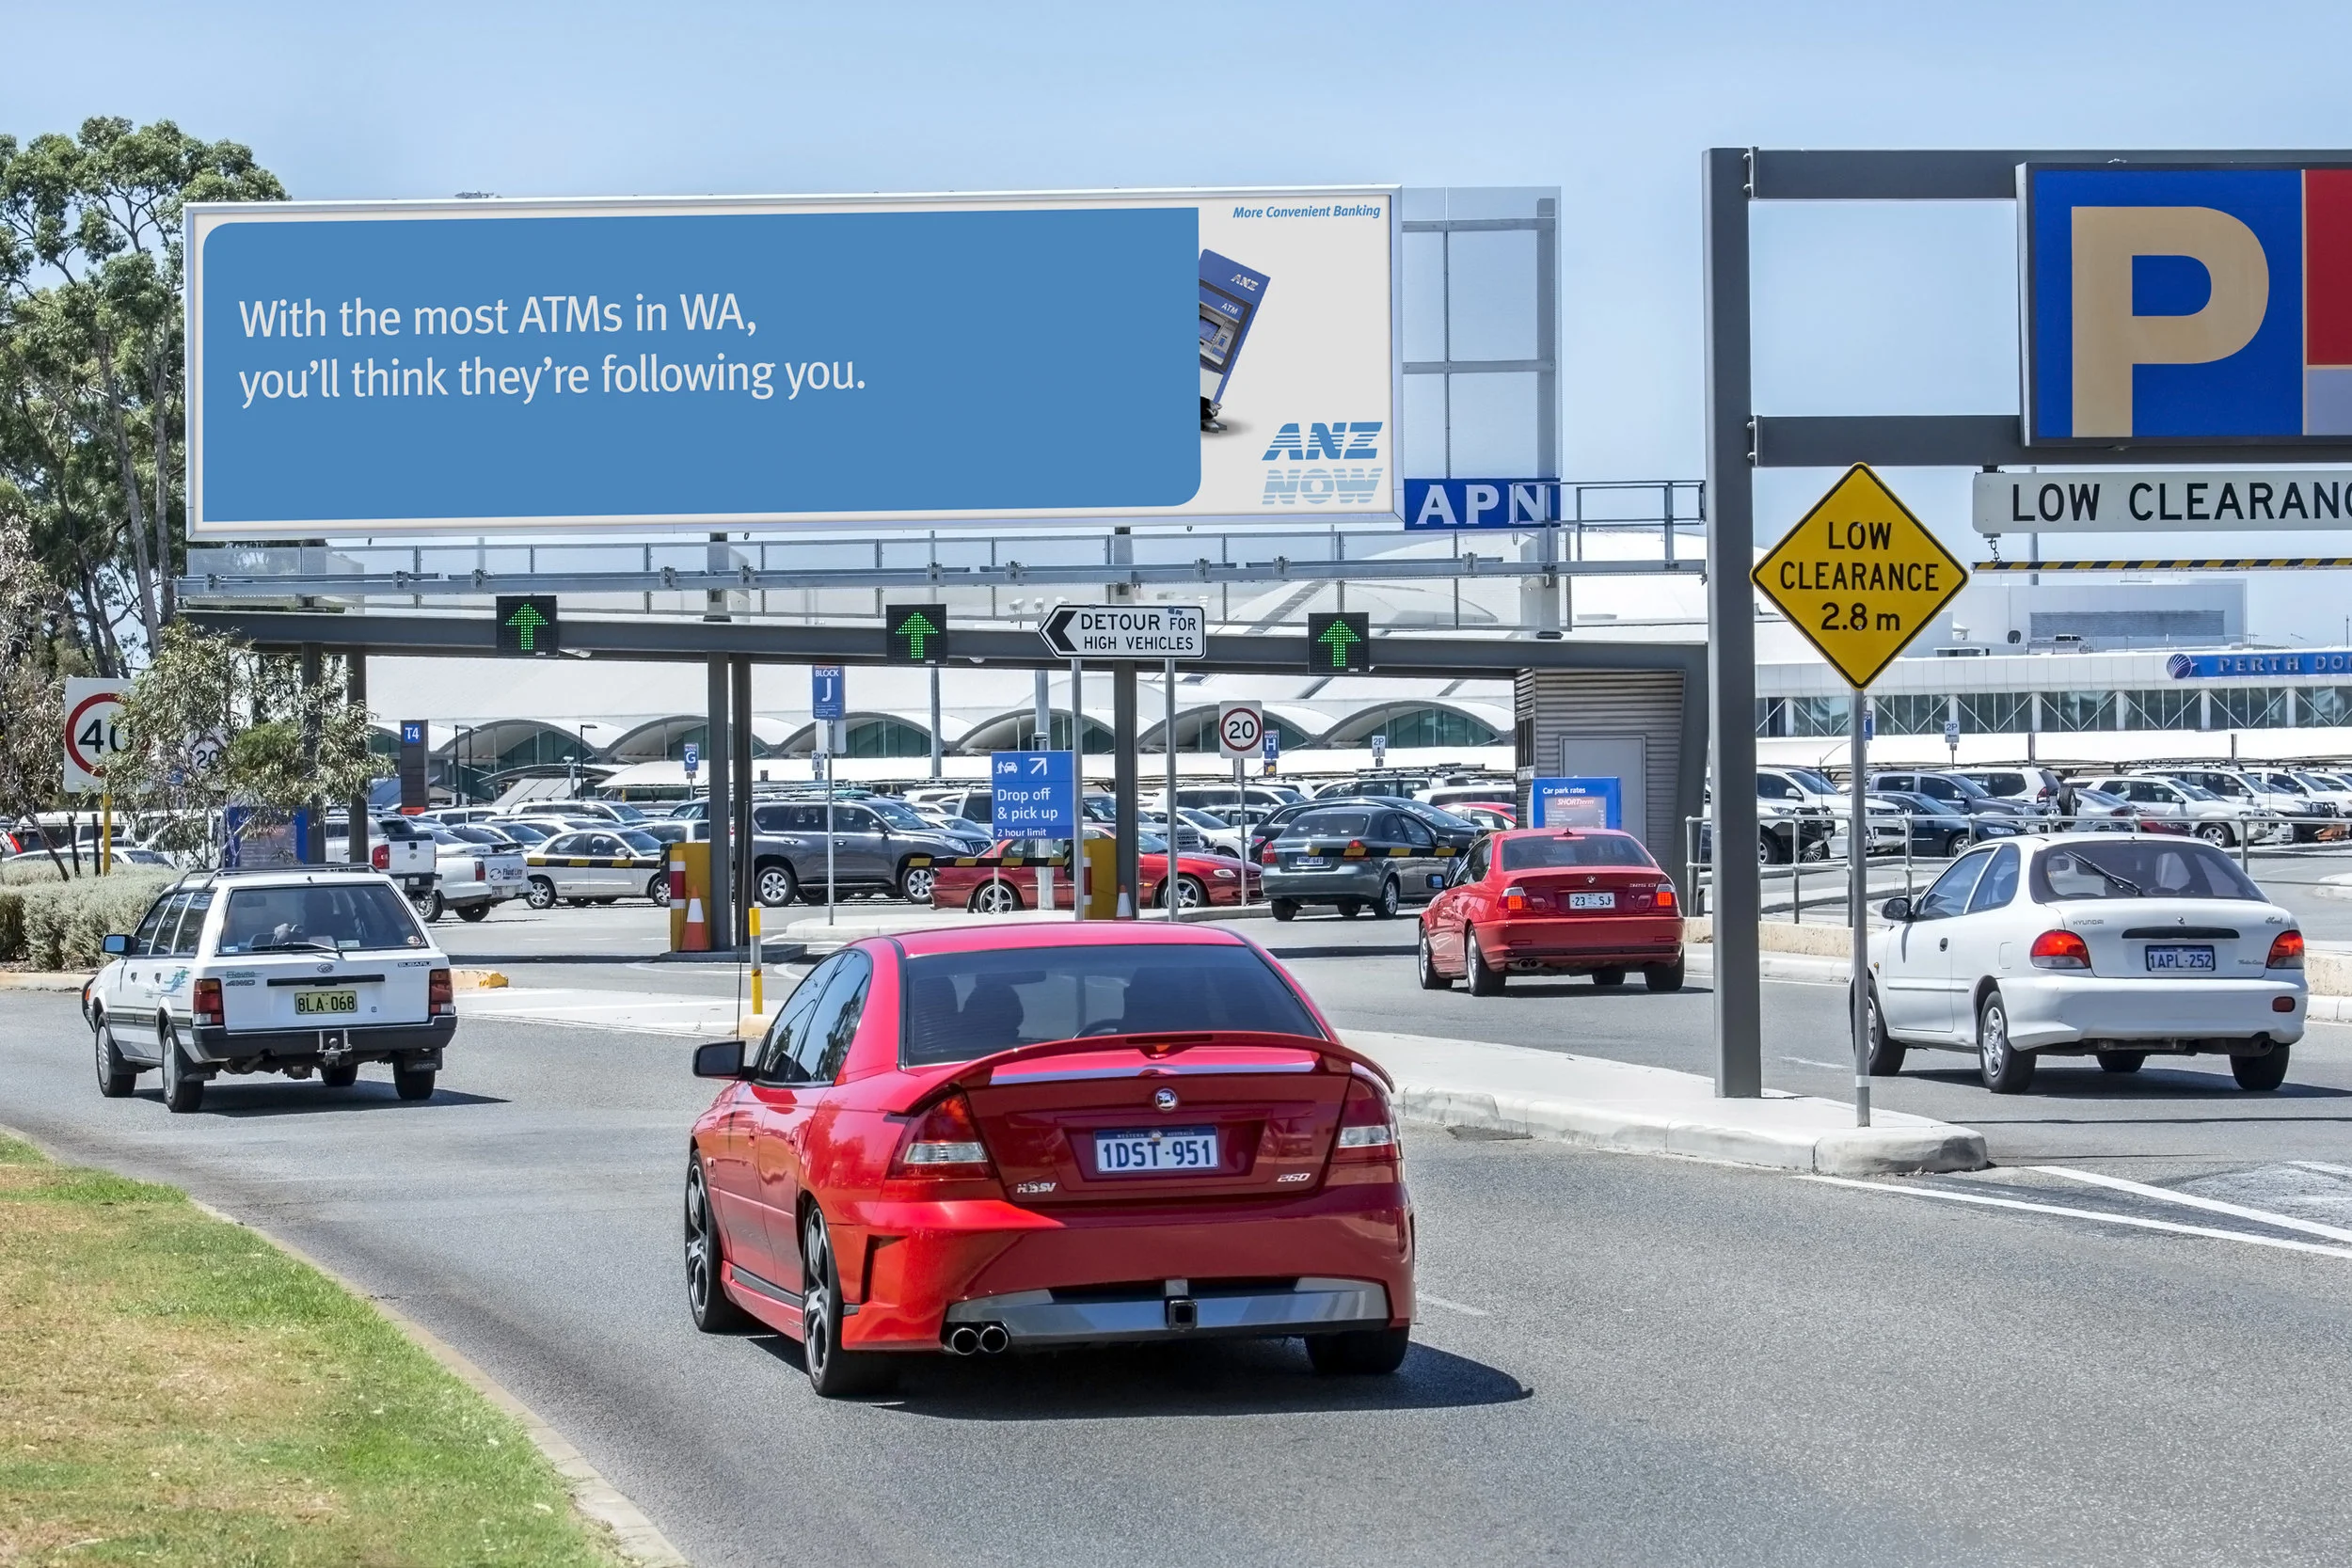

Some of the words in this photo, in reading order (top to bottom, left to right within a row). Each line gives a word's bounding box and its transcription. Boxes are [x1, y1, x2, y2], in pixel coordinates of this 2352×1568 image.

[1232, 207, 1263, 218] More
[1265, 206, 1330, 217] Convenient
[1333, 204, 1380, 218] Banking
[1231, 274, 1259, 292] ANZ
[239, 296, 327, 338] With
[340, 296, 401, 336] the
[414, 298, 509, 335] most
[518, 294, 623, 333] ATMs
[636, 293, 667, 331] in
[680, 293, 757, 337] WA,
[1221, 302, 1238, 315] ATM
[2072, 206, 2269, 437] P
[352, 356, 449, 396] think
[602, 353, 774, 400] following
[787, 357, 866, 403] you.
[1262, 421, 1383, 461] ANZ
[1262, 467, 1384, 505] NOW
[1415, 483, 1548, 525] APN
[2013, 483, 2101, 521] LOW
[1828, 522, 1892, 549] LOW
[1780, 562, 1939, 591] CLEARANCE
[1081, 613, 1160, 631] DETOUR
[1169, 617, 1196, 631] FOR
[1820, 602, 1867, 631] 2.8
[1876, 612, 1900, 631] m
[1084, 636, 1117, 649] HIGH
[1126, 637, 1194, 650] VEHICLES
[815, 669, 839, 677] BLOCK
[2217, 657, 2299, 673] PERTH
[821, 678, 833, 702] J
[78, 719, 131, 753] 40
[405, 727, 420, 740] T4
[1229, 721, 1255, 739] 20
[1947, 723, 1958, 732] 2P
[1266, 738, 1277, 751] H
[1373, 737, 1386, 746] 2P
[686, 752, 696, 763] G
[997, 789, 1029, 803] Drop
[1032, 786, 1052, 800] off
[997, 806, 1008, 820] &
[1011, 806, 1038, 822] pick
[1041, 808, 1058, 822] up
[997, 829, 1003, 837] 2
[1005, 829, 1025, 837] hour
[1026, 828, 1047, 836] limit
[1277, 1173, 1311, 1182] 260
